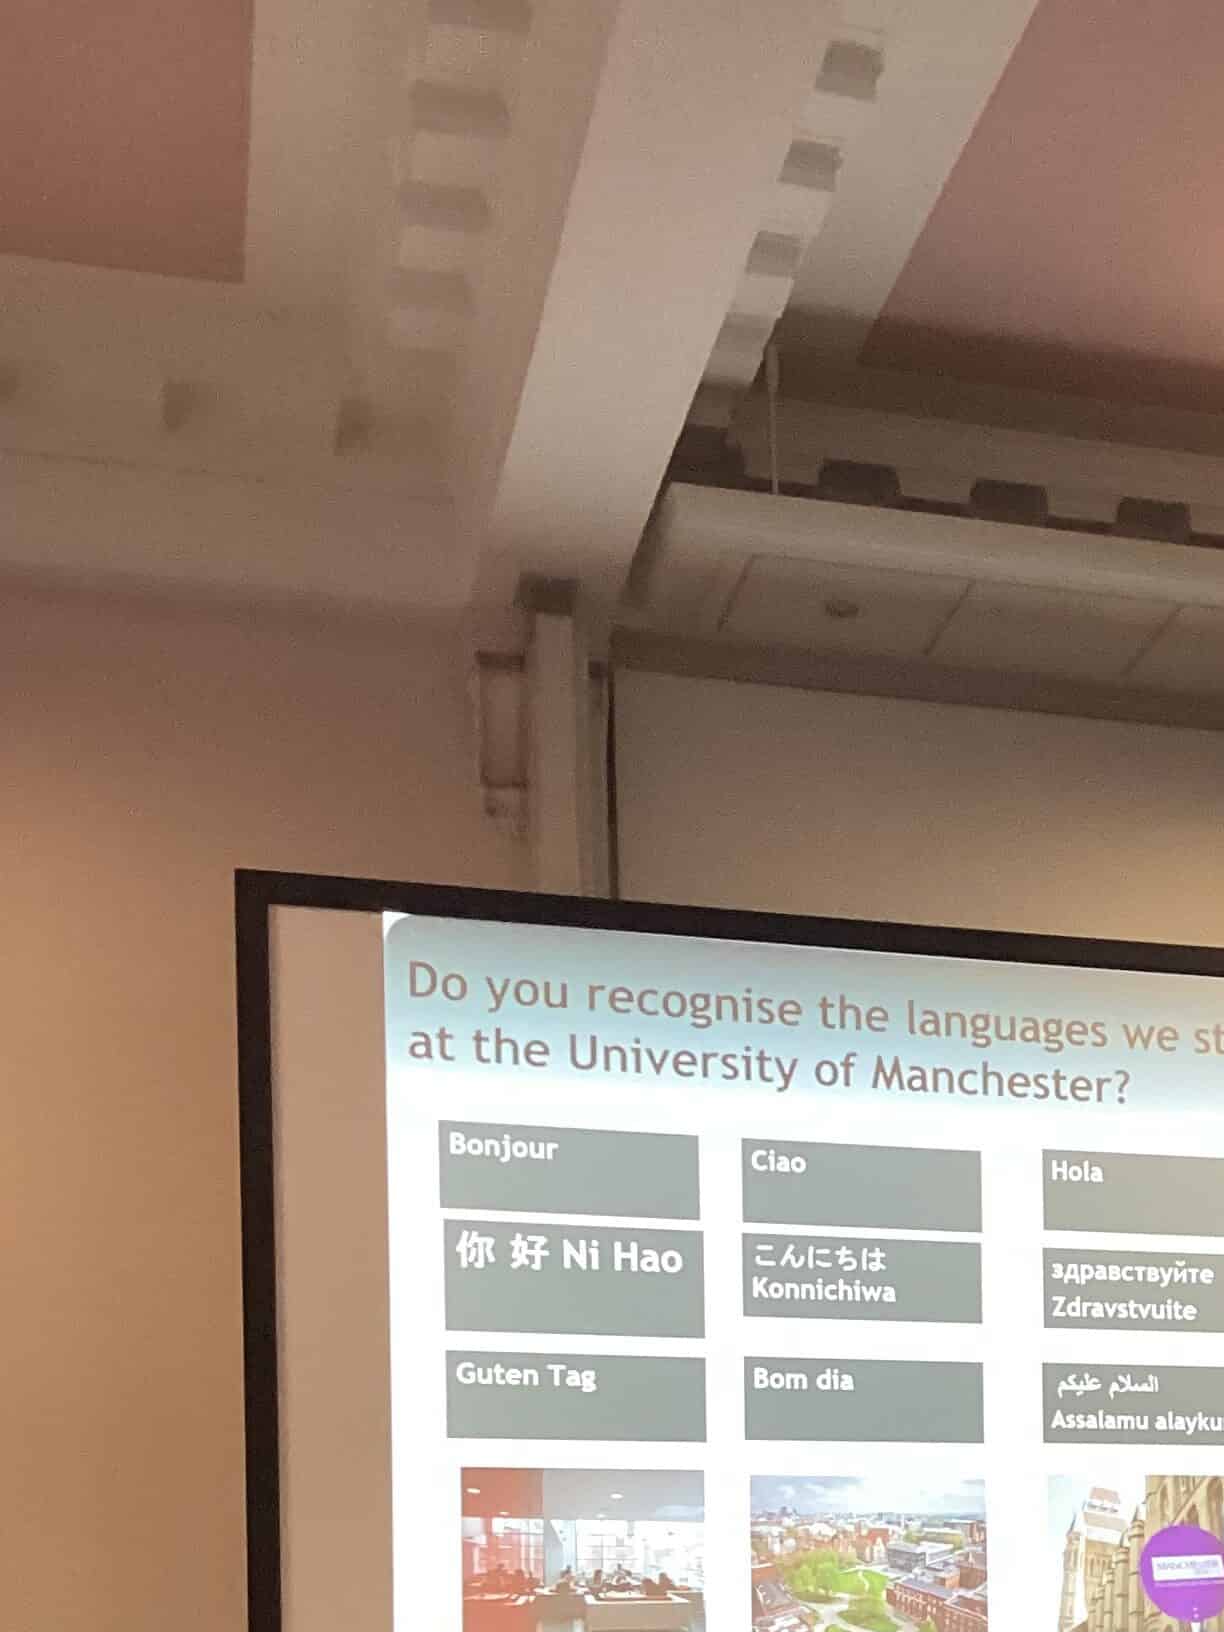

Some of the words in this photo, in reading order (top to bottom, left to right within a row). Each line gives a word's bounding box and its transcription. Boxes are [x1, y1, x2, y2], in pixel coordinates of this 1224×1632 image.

[409, 960, 467, 1001] Do
[486, 976, 568, 1013] you
[587, 982, 801, 1028] recognise
[819, 994, 889, 1033] the
[908, 1000, 1106, 1053] languages
[1122, 1022, 1178, 1053] we
[408, 1027, 455, 1061] at
[472, 1028, 549, 1068] the
[570, 1033, 798, 1093] University
[815, 1052, 857, 1087] of
[872, 1055, 1130, 1105] Manchester?
[449, 1132, 559, 1163] Bonjour
[751, 1150, 806, 1173] Ciao
[1051, 1160, 1104, 1183] Hola
[563, 1240, 600, 1271] Ni
[613, 1242, 683, 1273] Hao
[754, 1244, 887, 1272] こんにちは
[1051, 1260, 1214, 1288] здравствуйте
[752, 1276, 897, 1303] Konnichiwa
[1052, 1296, 1198, 1321] Zdravstvuite
[456, 1362, 539, 1387] Guten
[547, 1365, 597, 1393] Tag
[753, 1367, 808, 1391] Bom
[816, 1368, 854, 1392] dia
[1051, 1410, 1149, 1431] Assalamu
